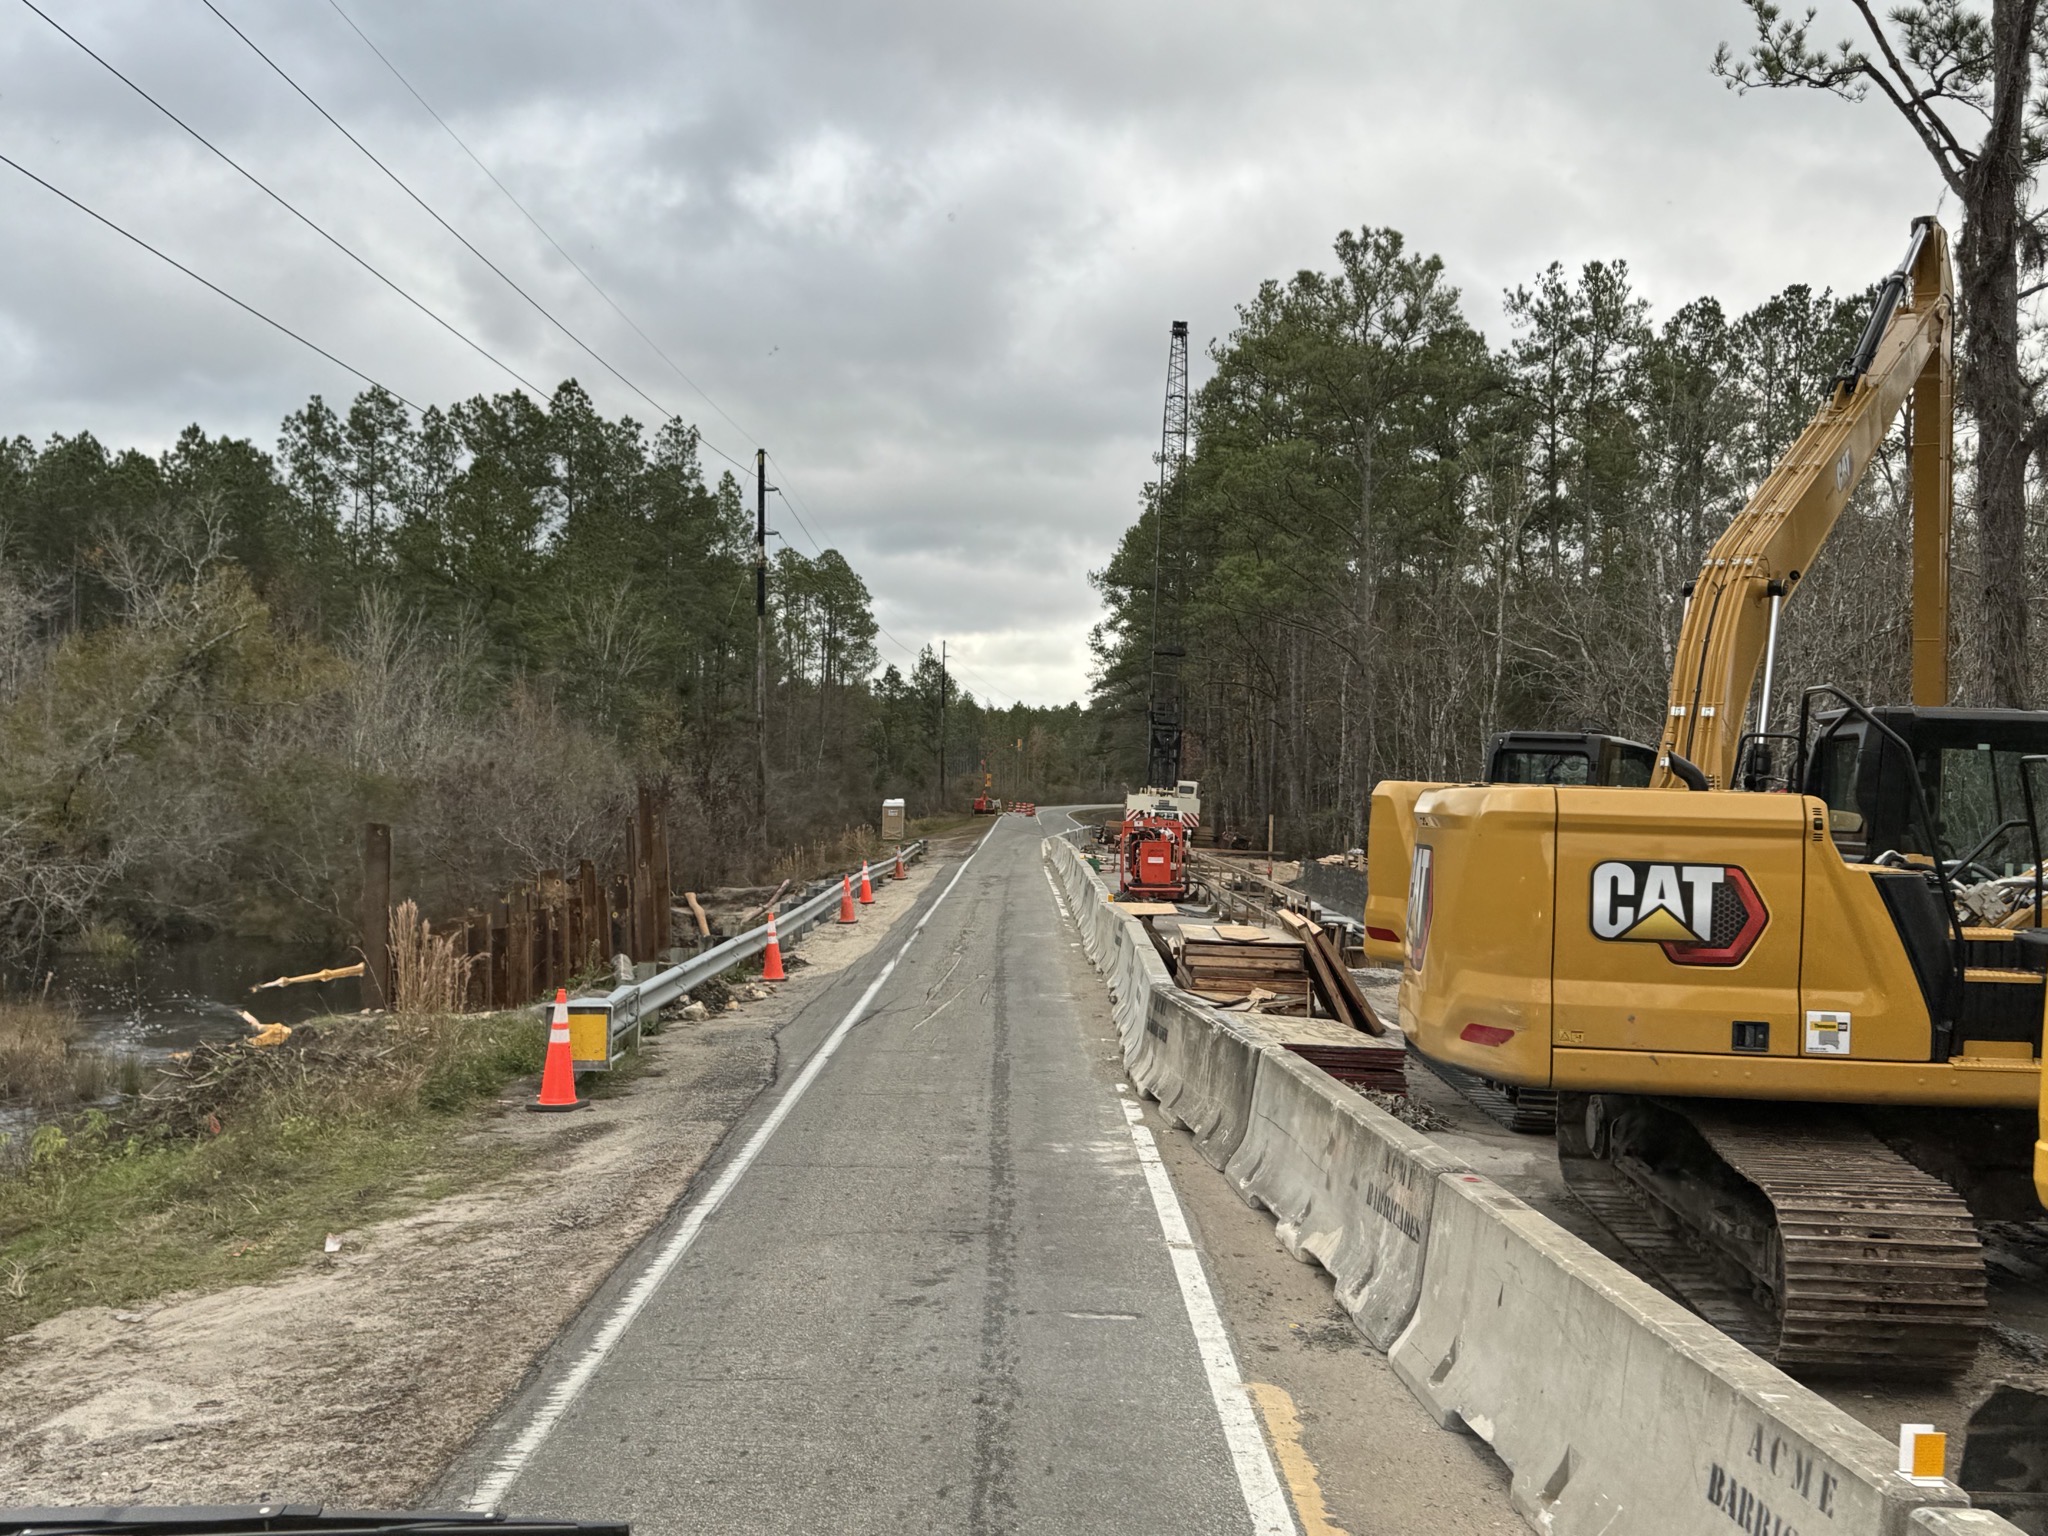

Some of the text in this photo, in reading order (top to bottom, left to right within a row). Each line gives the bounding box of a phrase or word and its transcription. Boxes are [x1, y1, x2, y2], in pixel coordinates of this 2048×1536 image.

[1836, 448, 1850, 491] CAT
[1592, 862, 1725, 941] CAT
[1747, 1422, 1838, 1519] ACME
